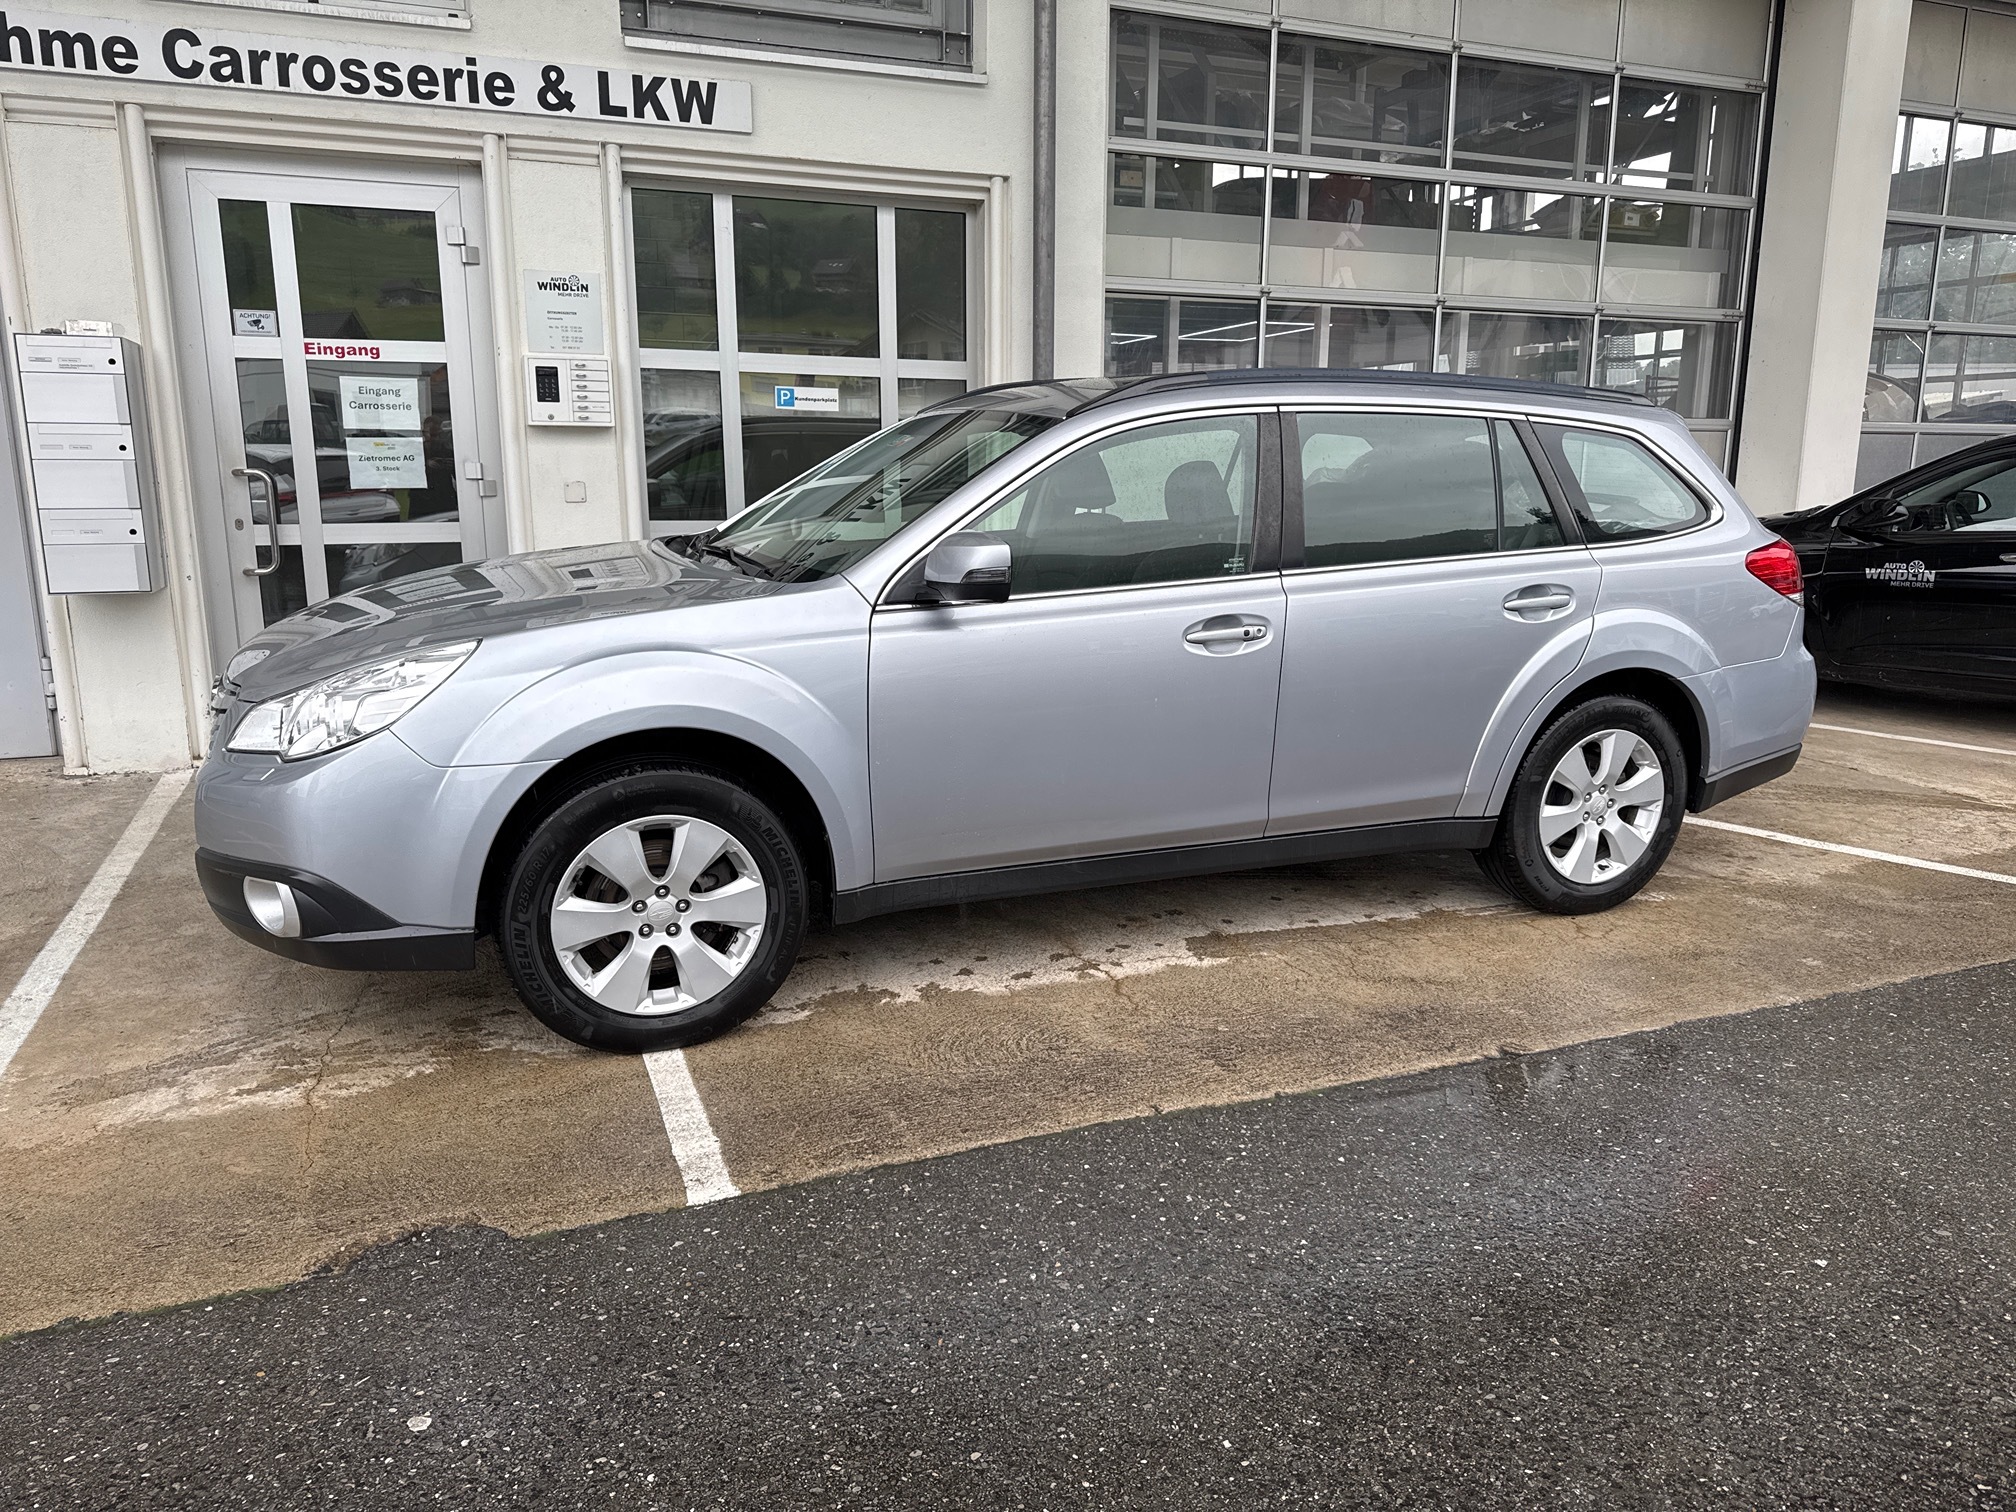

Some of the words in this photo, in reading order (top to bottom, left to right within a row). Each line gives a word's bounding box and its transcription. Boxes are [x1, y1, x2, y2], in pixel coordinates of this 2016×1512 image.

[0, 11, 139, 74] hme
[162, 28, 516, 107] Carrosserie
[537, 64, 576, 113] &
[597, 70, 718, 125] LKW
[537, 281, 589, 293] WINDLIN
[239, 312, 271, 320] ACHTUNG!
[304, 342, 381, 359] Eingang
[358, 386, 402, 397] Eingang
[780, 390, 791, 405] P
[349, 400, 412, 411] Carrosserie
[403, 454, 415, 462] AG
[1883, 562, 1907, 570] AUTO
[1865, 567, 1936, 582] WINDLIN
[1890, 580, 1910, 588] MEHR
[1911, 581, 1934, 589] DRIVE
[762, 826, 802, 909] MICHELIN
